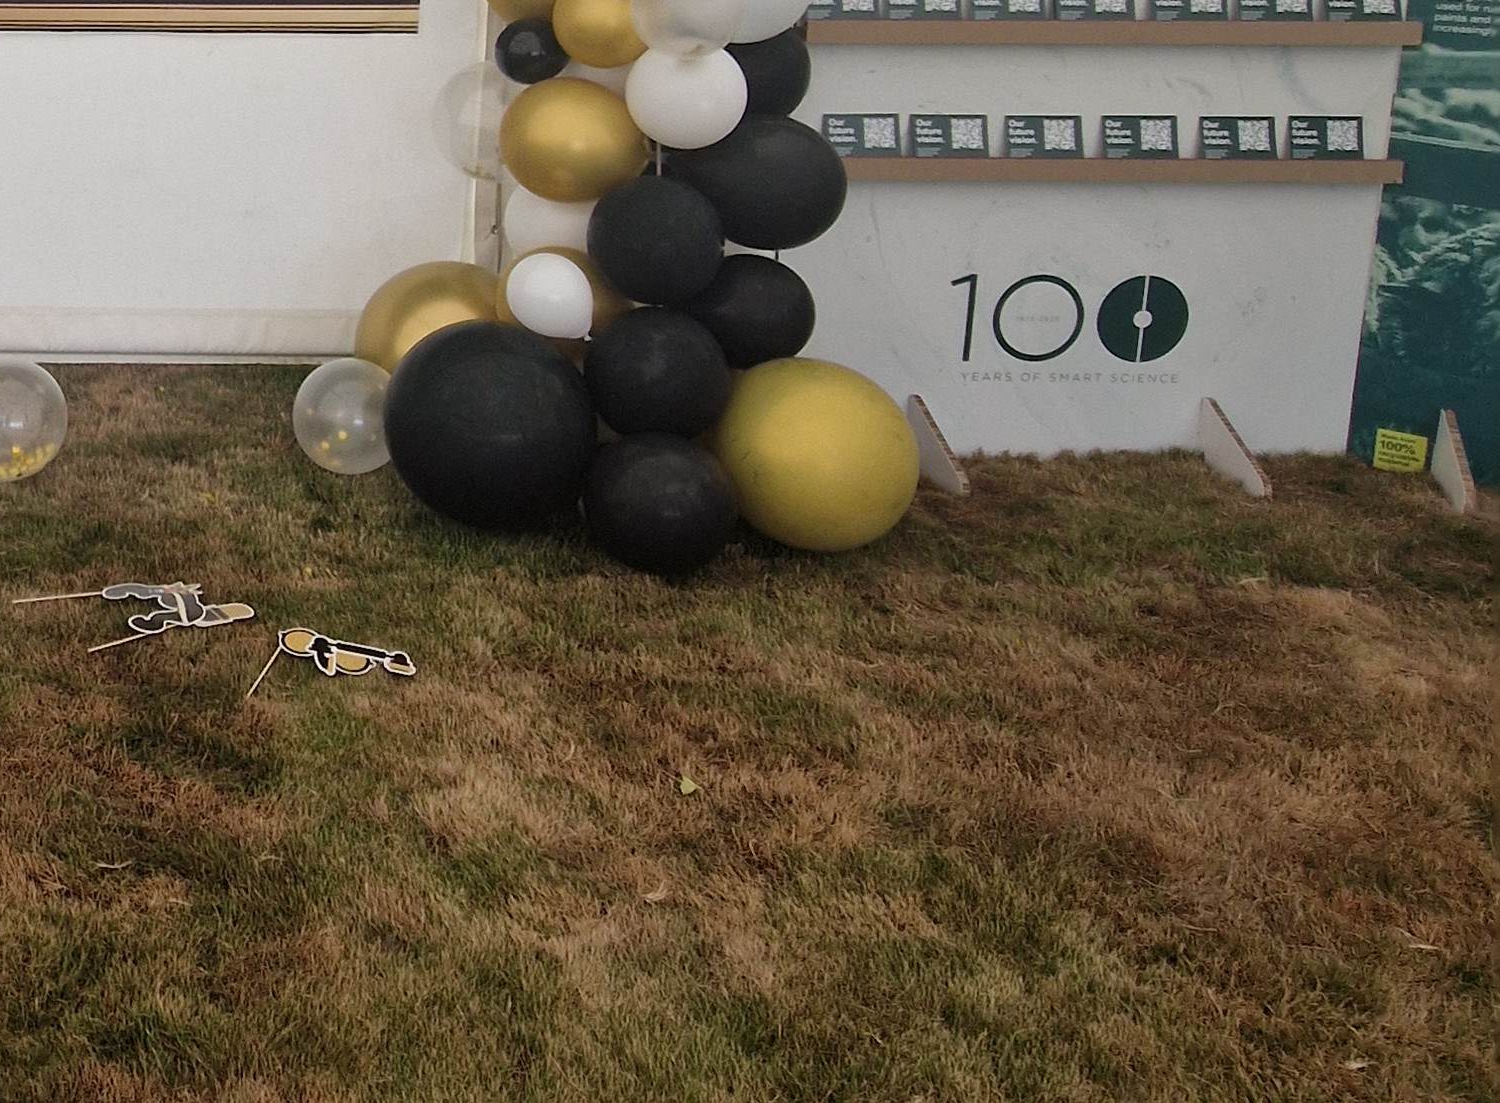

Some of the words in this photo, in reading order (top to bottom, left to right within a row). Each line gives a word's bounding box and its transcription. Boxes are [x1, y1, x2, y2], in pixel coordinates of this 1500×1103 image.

[828, 119, 846, 127] Our
[916, 119, 933, 127] Our
[1009, 120, 1026, 128] Our
[1105, 120, 1122, 128] Our
[1203, 120, 1220, 129] Our
[1292, 120, 1309, 129] Our
[828, 128, 856, 136] future
[916, 128, 943, 136] future
[1009, 129, 1036, 137] future
[1105, 129, 1132, 137] future
[1203, 129, 1230, 138] future
[1292, 129, 1319, 138] future
[828, 136, 858, 145] vision.
[916, 136, 945, 145] vision.
[1009, 137, 1038, 146] vision.
[1105, 137, 1135, 146] vision.
[1203, 137, 1232, 147] vision.
[1292, 137, 1321, 147] vision.
[950, 272, 1190, 363] 100
[960, 371, 1013, 383] YEARS
[1020, 371, 1042, 383] OF
[1050, 372, 1102, 384] SMART
[1110, 373, 1180, 384] SCIENCE
[1379, 439, 1416, 455] 100%
